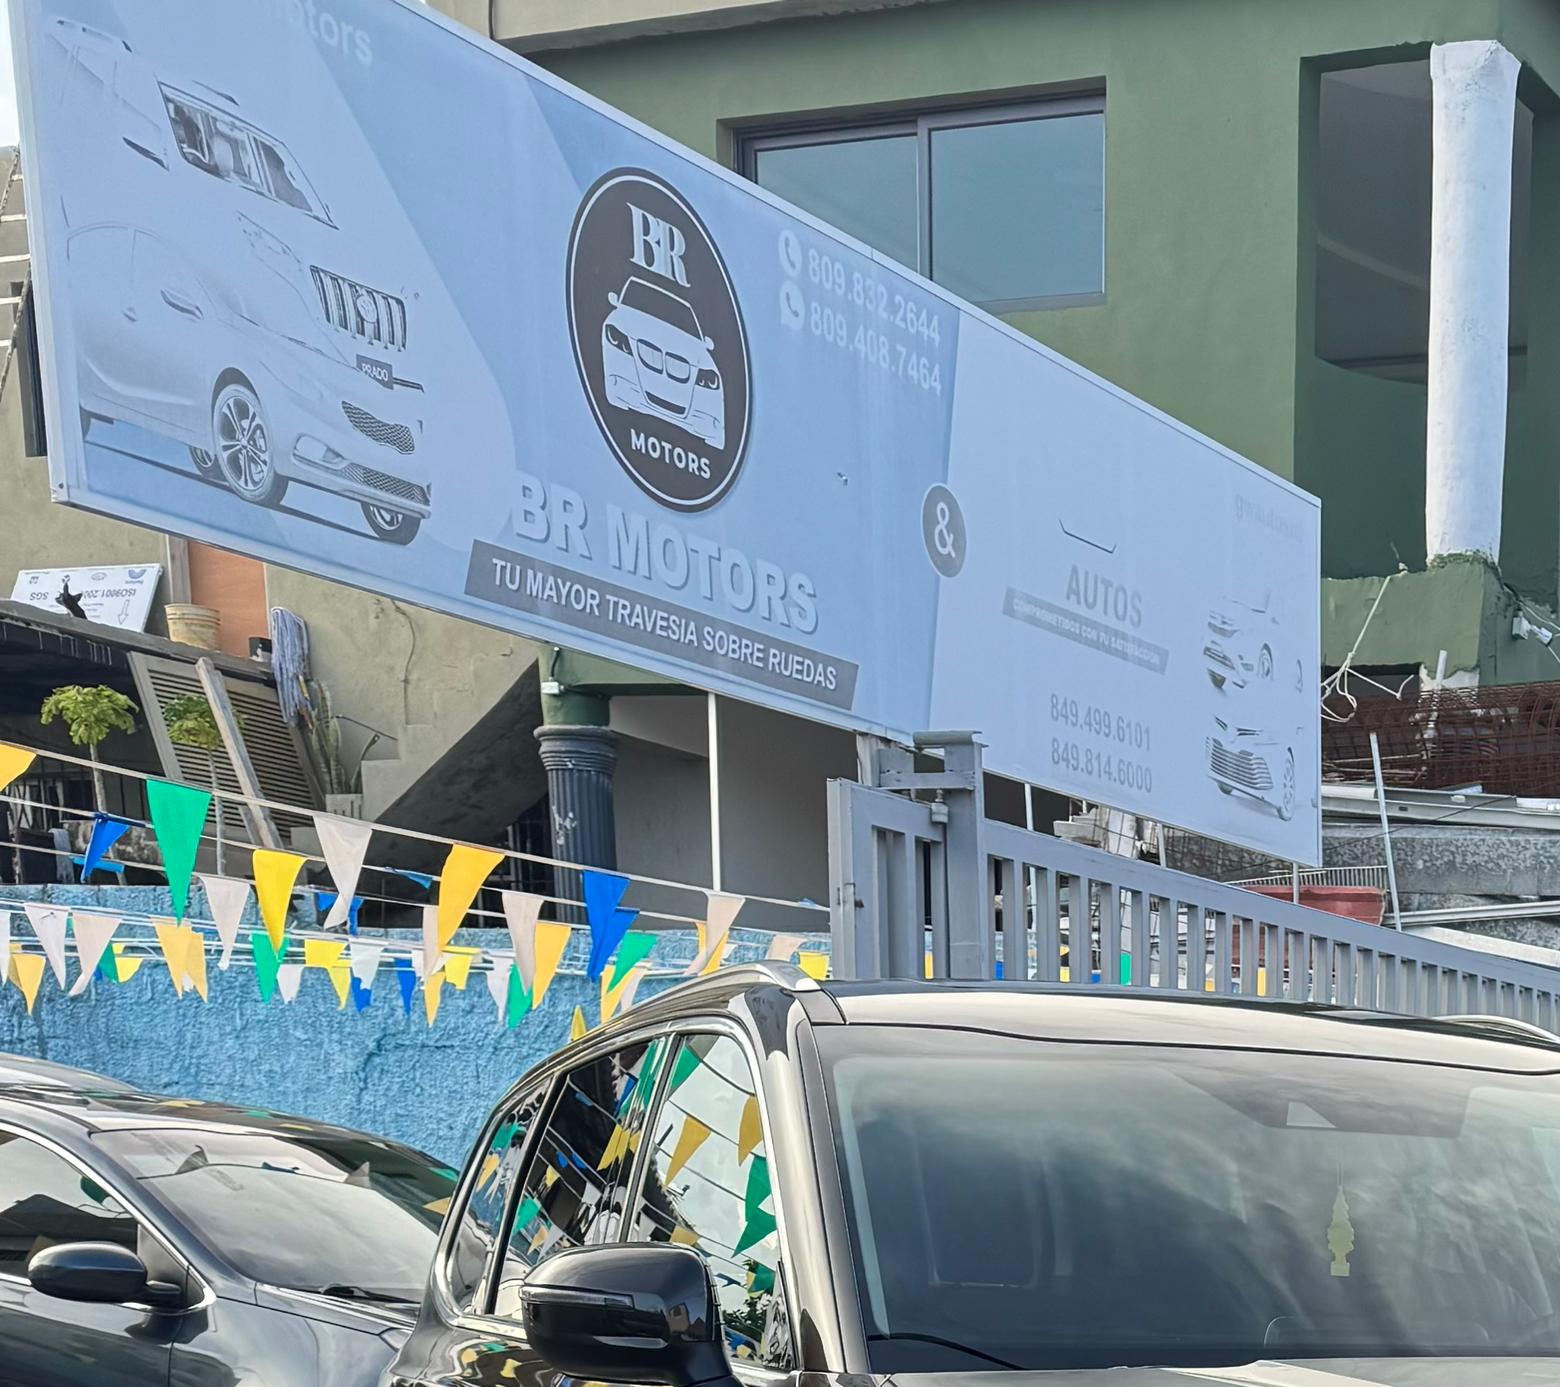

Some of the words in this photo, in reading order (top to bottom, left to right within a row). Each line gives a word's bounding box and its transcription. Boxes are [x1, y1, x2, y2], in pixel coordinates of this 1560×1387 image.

[626, 202, 691, 288] BR
[808, 248, 940, 348] 809.832.2644
[362, 363, 389, 382] PRADO
[810, 301, 942, 397] 809.408.7464
[629, 428, 711, 480] MOTORS
[511, 469, 593, 561] BR
[606, 504, 819, 635] MOTORS
[491, 558, 520, 591] TU
[526, 569, 600, 616] MAYOR
[606, 594, 698, 647] TRAVESIA
[702, 626, 764, 668] SOBRE
[768, 647, 837, 690] RUEDAS
[1065, 563, 1143, 629] AUTOS
[1050, 692, 1151, 753] 849.499.6101
[1051, 736, 1153, 794] 849.814.6000
